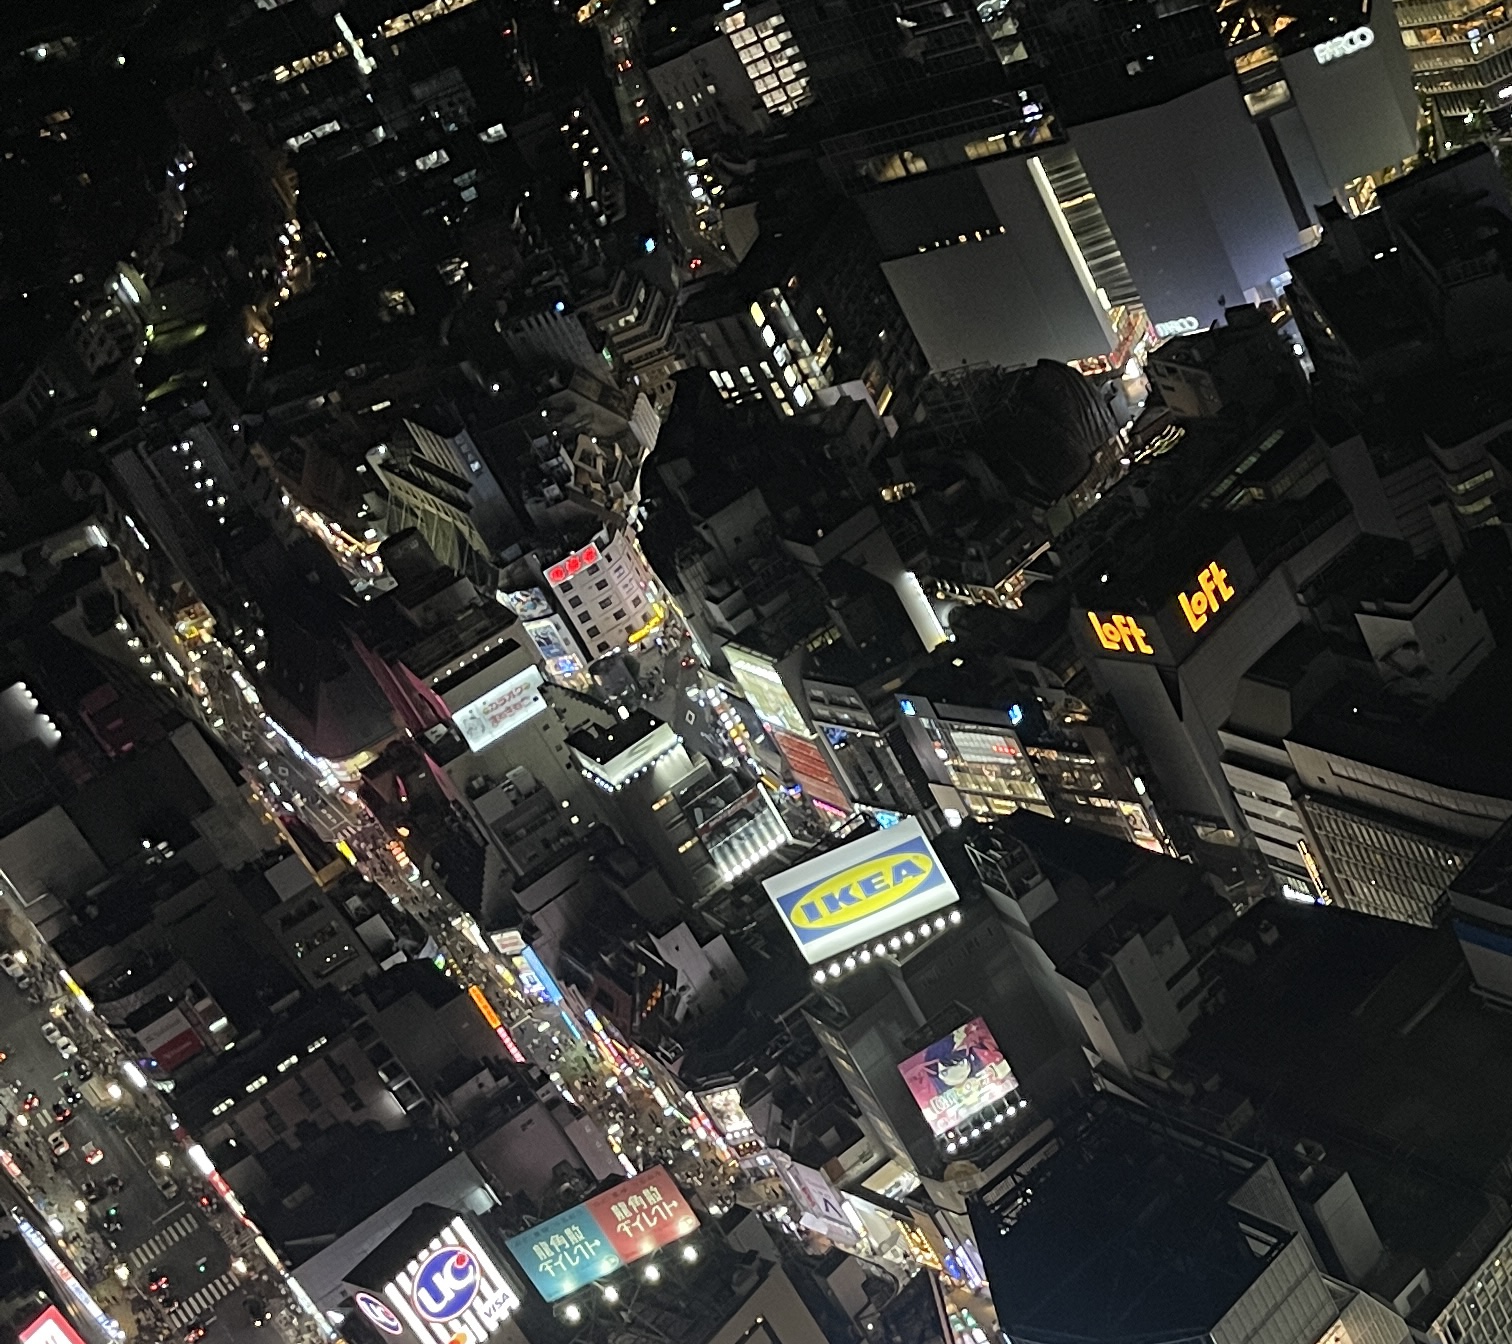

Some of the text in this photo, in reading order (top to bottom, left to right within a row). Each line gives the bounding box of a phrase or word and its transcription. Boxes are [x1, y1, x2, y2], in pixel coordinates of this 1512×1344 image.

[1312, 26, 1374, 65] PARCO
[799, 860, 928, 923] IKEA
[484, 1293, 511, 1319] VISA
